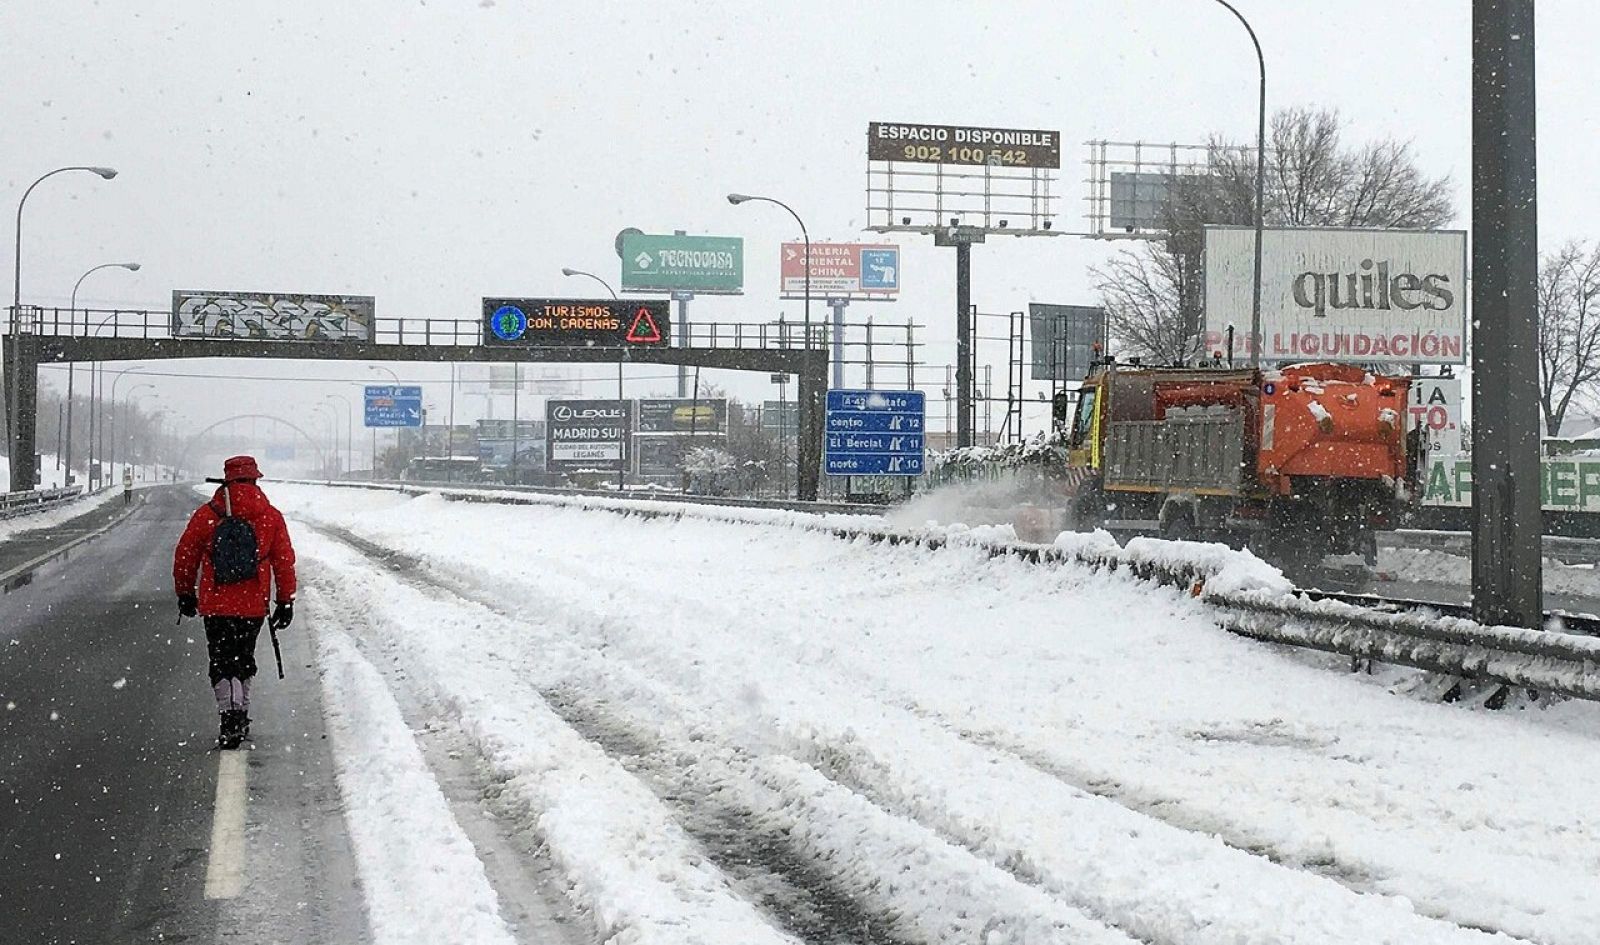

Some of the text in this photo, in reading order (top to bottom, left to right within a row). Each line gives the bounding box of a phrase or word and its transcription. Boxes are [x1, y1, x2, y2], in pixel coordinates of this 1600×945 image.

[878, 125, 1052, 147] ESPACIO DISPONIBLE
[904, 146, 941, 161] 902
[948, 148, 984, 162] 100
[659, 249, 733, 269] TECNOCASA
[810, 267, 846, 276] CHINA
[1292, 257, 1455, 318] quiles
[544, 305, 610, 317] TURISMOS
[527, 318, 619, 330] CON CADENAS
[1273, 330, 1462, 357] LIQUIDACIÓN
[1415, 381, 1447, 405] ÍA
[573, 408, 626, 418] LEXUS
[1409, 404, 1456, 431] TO.
[830, 417, 919, 428] centro 12
[553, 428, 600, 439] MADRID
[830, 438, 919, 449] El Bercial 11
[829, 459, 919, 469] norte 10
